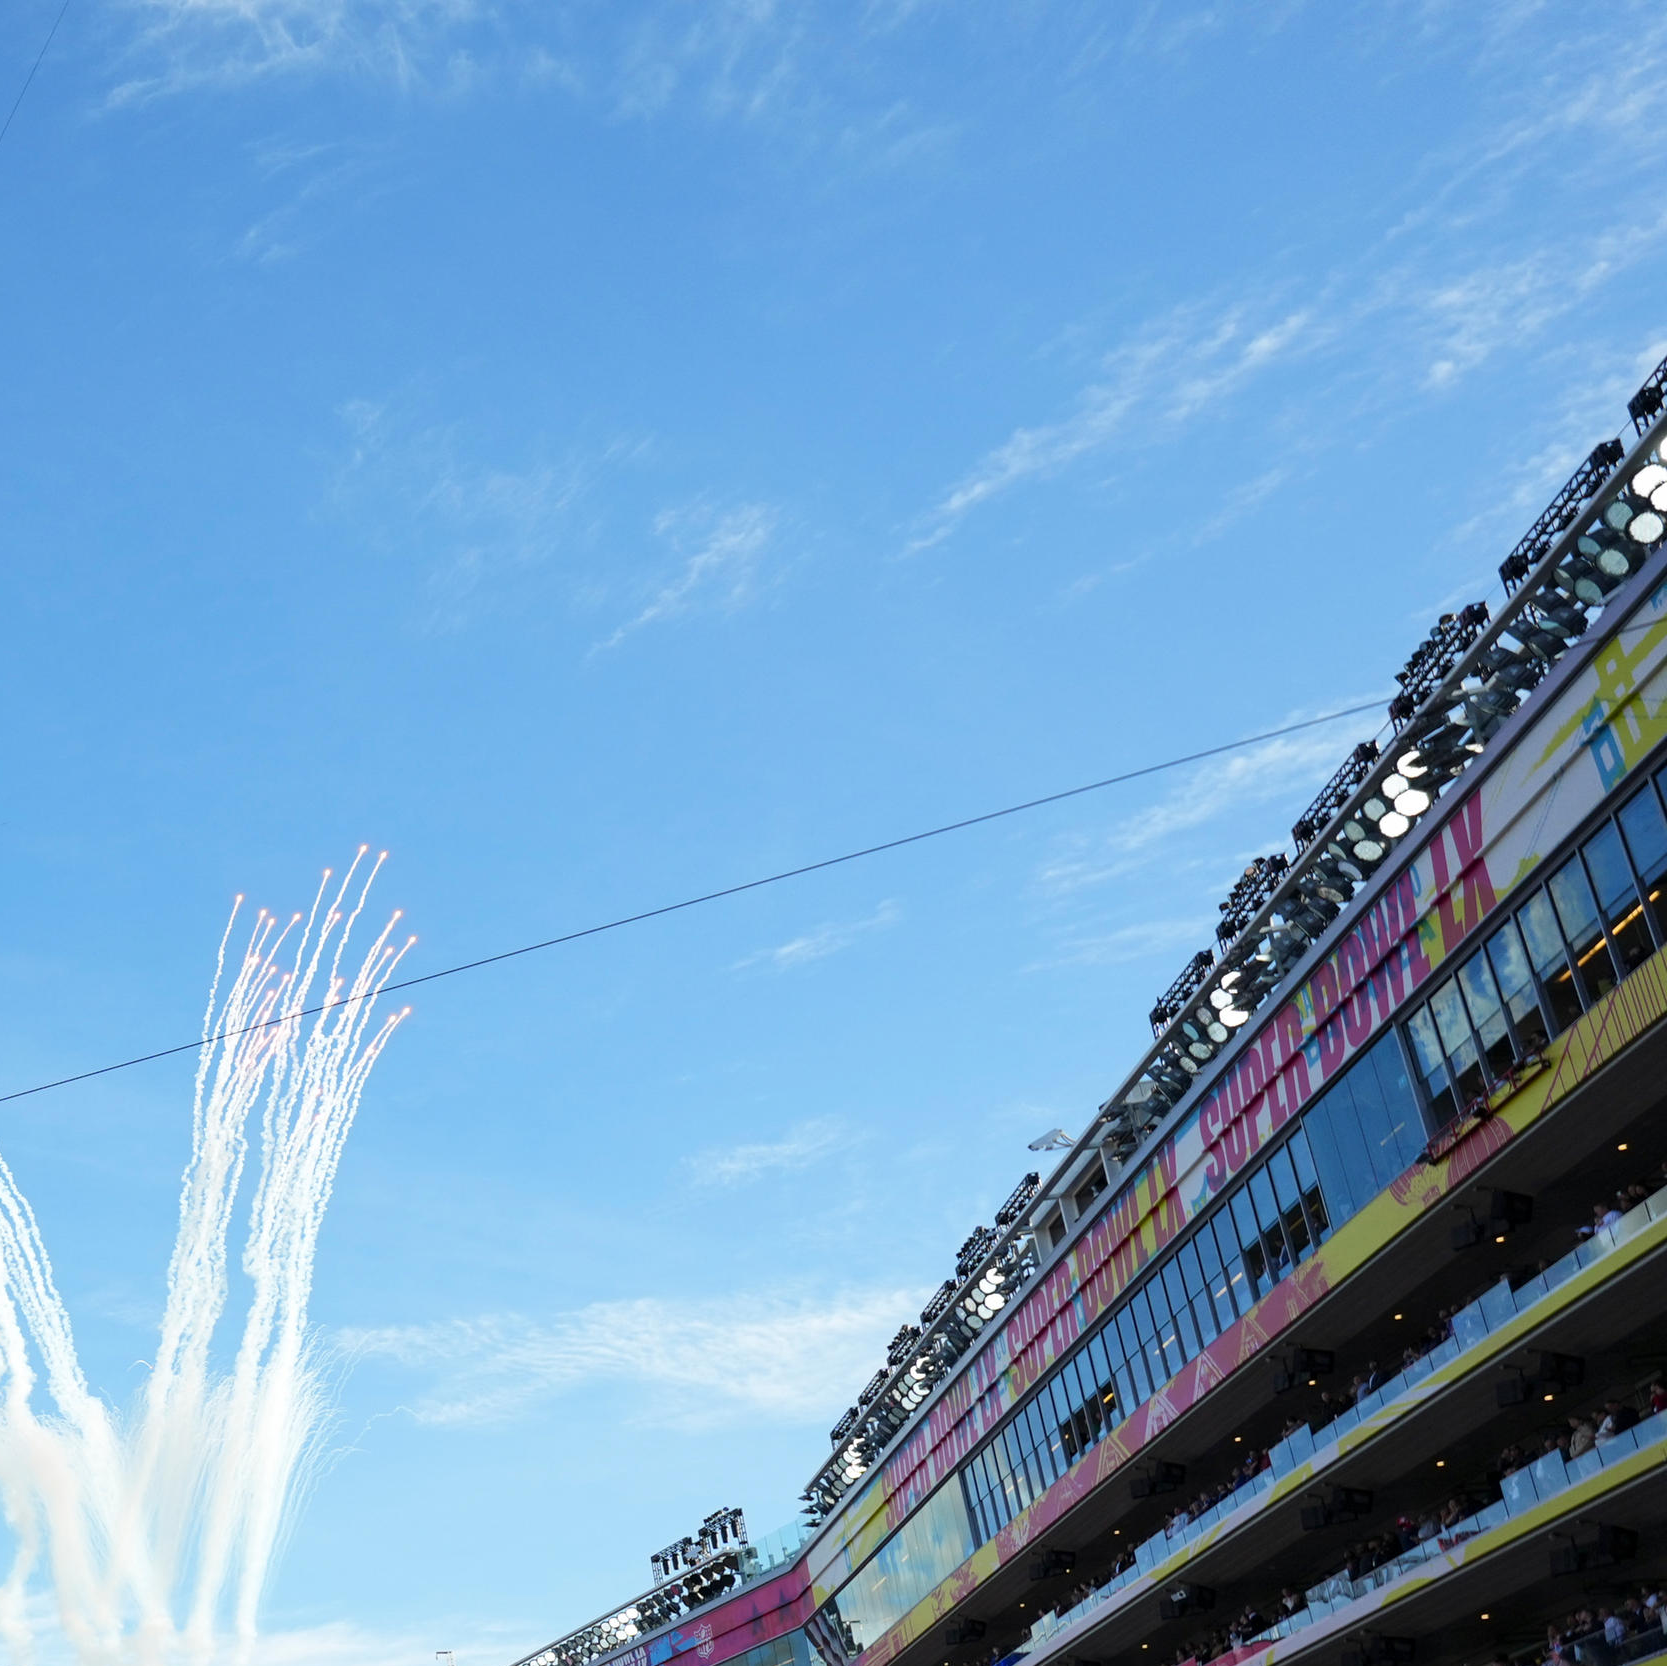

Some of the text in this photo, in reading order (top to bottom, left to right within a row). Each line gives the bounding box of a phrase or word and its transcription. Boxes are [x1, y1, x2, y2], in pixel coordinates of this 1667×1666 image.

[1201, 798, 1497, 1182] SUPER BOWL LX
[1007, 1134, 1188, 1385] SUPER BOWL LX
[881, 1440, 930, 1531] SUPER
[930, 1386, 978, 1479] BOWL
